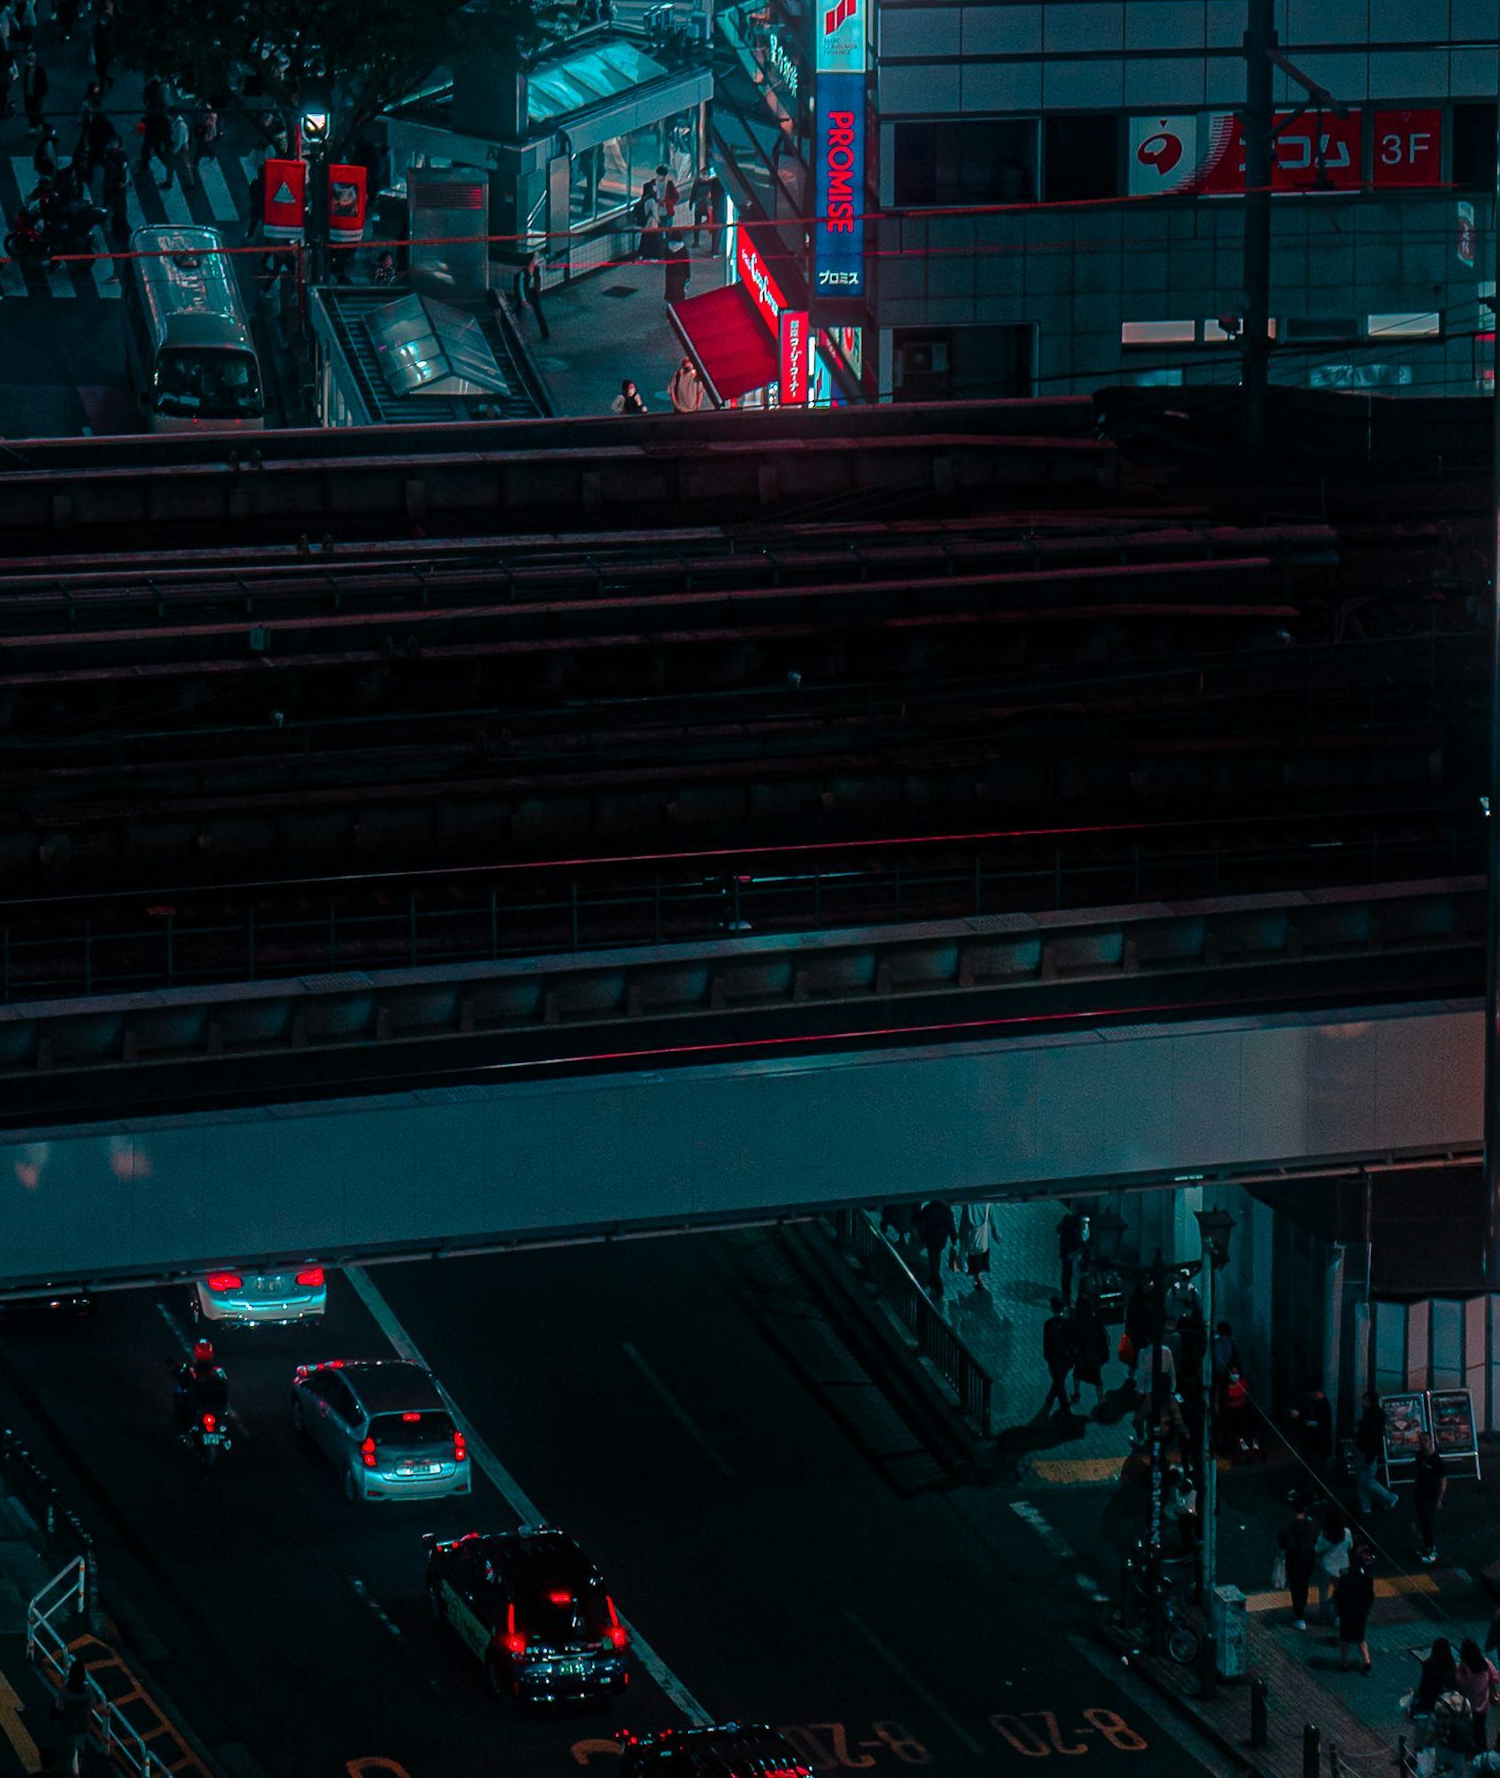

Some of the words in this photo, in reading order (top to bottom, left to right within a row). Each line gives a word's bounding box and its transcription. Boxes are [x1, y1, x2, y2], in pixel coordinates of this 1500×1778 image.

[1379, 132, 1432, 166] 3F
[827, 110, 855, 234] PROMISE
[818, 271, 860, 286] プロミス
